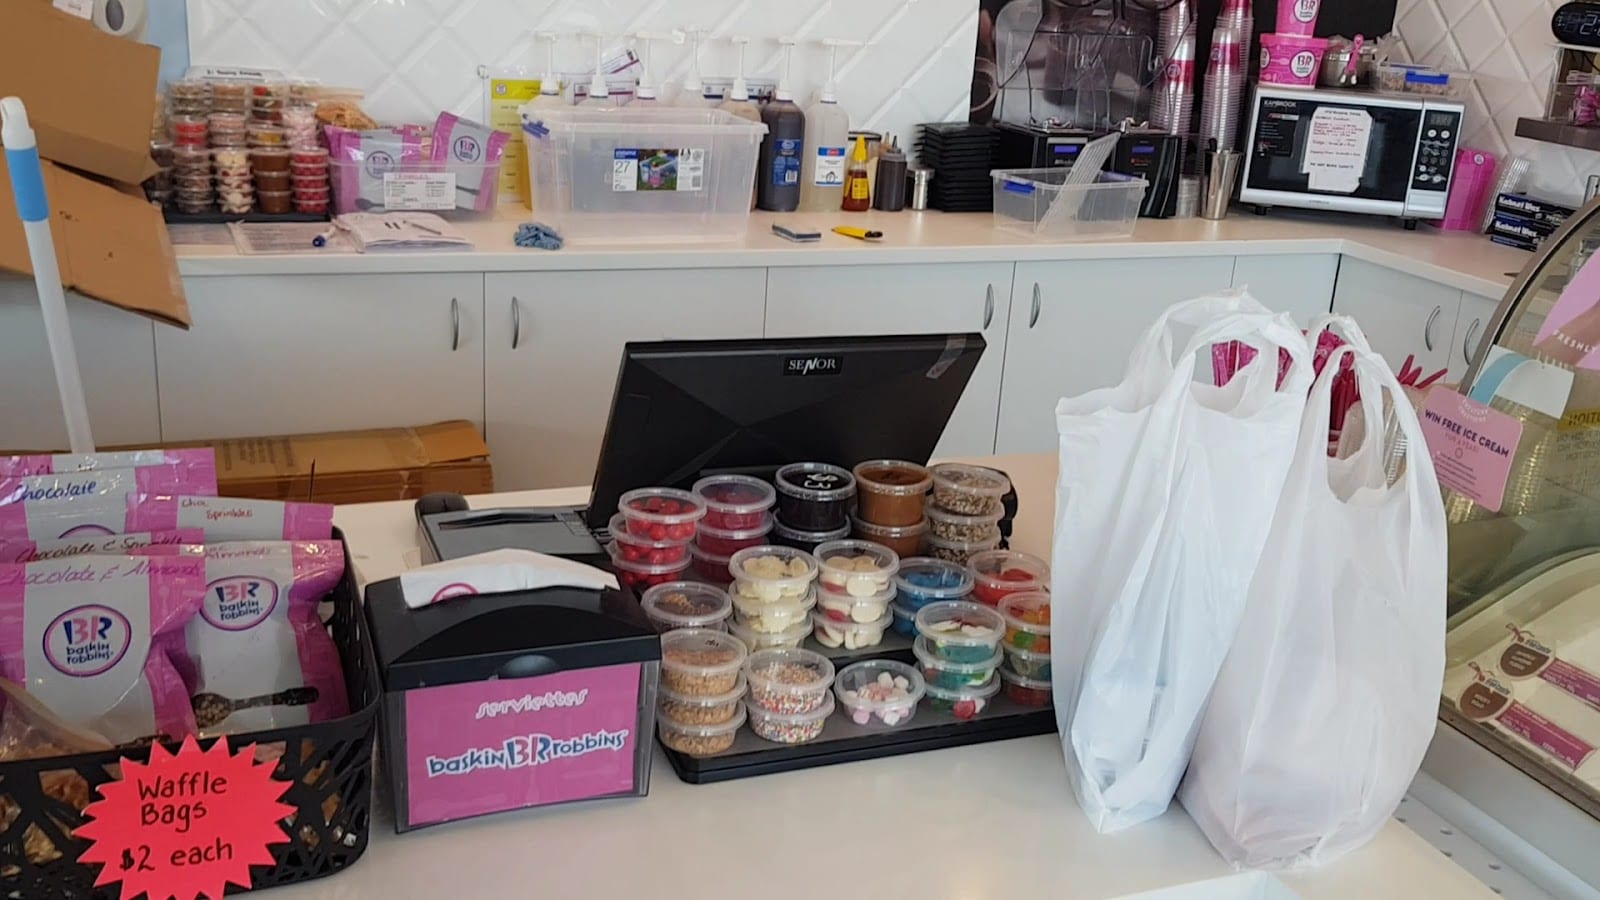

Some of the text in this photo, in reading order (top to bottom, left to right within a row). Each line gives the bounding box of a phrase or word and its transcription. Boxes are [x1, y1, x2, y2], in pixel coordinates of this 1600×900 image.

[615, 161, 631, 174] 27
[1553, 329, 1596, 354] FRESHLY
[788, 358, 836, 375] SENOR
[1424, 409, 1441, 425] WIN
[1442, 418, 1462, 434] FREE
[1463, 428, 1478, 442] ICE
[1478, 436, 1510, 458] CREAM
[206, 508, 253, 521] Sprinkles
[15, 542, 97, 563] Chocolate
[123, 560, 200, 578] Almonds
[215, 581, 261, 603] BR
[219, 599, 259, 613] baskin
[220, 607, 261, 621] robbins
[64, 616, 113, 645] BR
[66, 641, 110, 656] baskin
[67, 651, 113, 664] robbins
[476, 689, 588, 719] serviettes
[427, 730, 629, 777] baskin BR robbins
[137, 771, 229, 800] Waffle
[141, 800, 208, 832] Bags
[119, 837, 234, 871] $2 each
